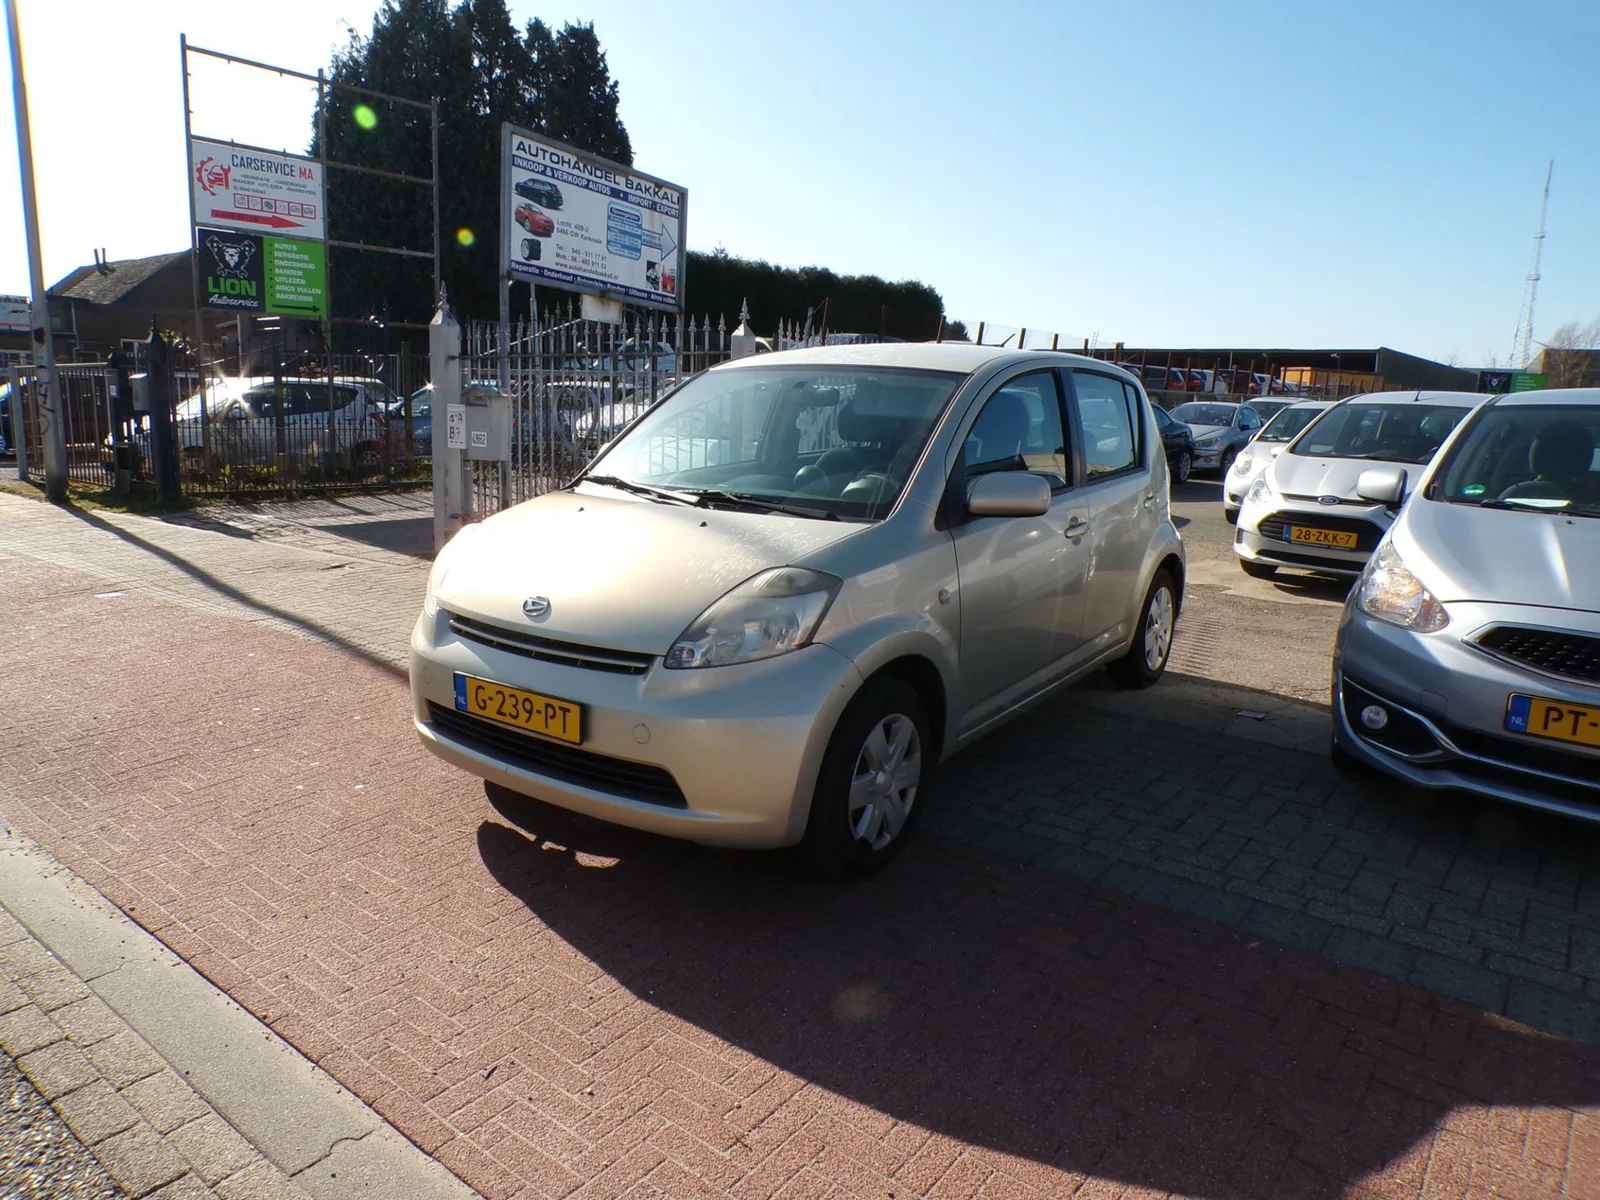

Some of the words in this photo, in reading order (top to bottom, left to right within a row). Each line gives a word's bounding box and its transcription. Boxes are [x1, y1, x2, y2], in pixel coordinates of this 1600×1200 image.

[231, 154, 296, 178] CARSERVICE
[299, 166, 314, 180] MA
[515, 140, 620, 185] AUTOHANDEL
[624, 177, 680, 206] BAKKALI
[514, 156, 544, 173] INKOOP
[545, 167, 552, 177] &
[553, 169, 588, 187] VERKOOP
[588, 182, 611, 195] AUTOS
[627, 193, 652, 209] IMPORT
[656, 203, 680, 218] EXPORT
[274, 251, 309, 261] REPARATIE
[274, 260, 316, 270] ONDERHOUD
[275, 268, 303, 277] BANDEN
[511, 261, 540, 275] Reparatie
[543, 268, 573, 282] Onderhoud
[207, 276, 257, 296] LION
[275, 276, 306, 285] UITLEZEN
[208, 293, 259, 308] Autoservice
[1296, 528, 1353, 545] 28-ZKK-7
[475, 685, 571, 734] G-239-PT
[1511, 716, 1524, 725] NL
